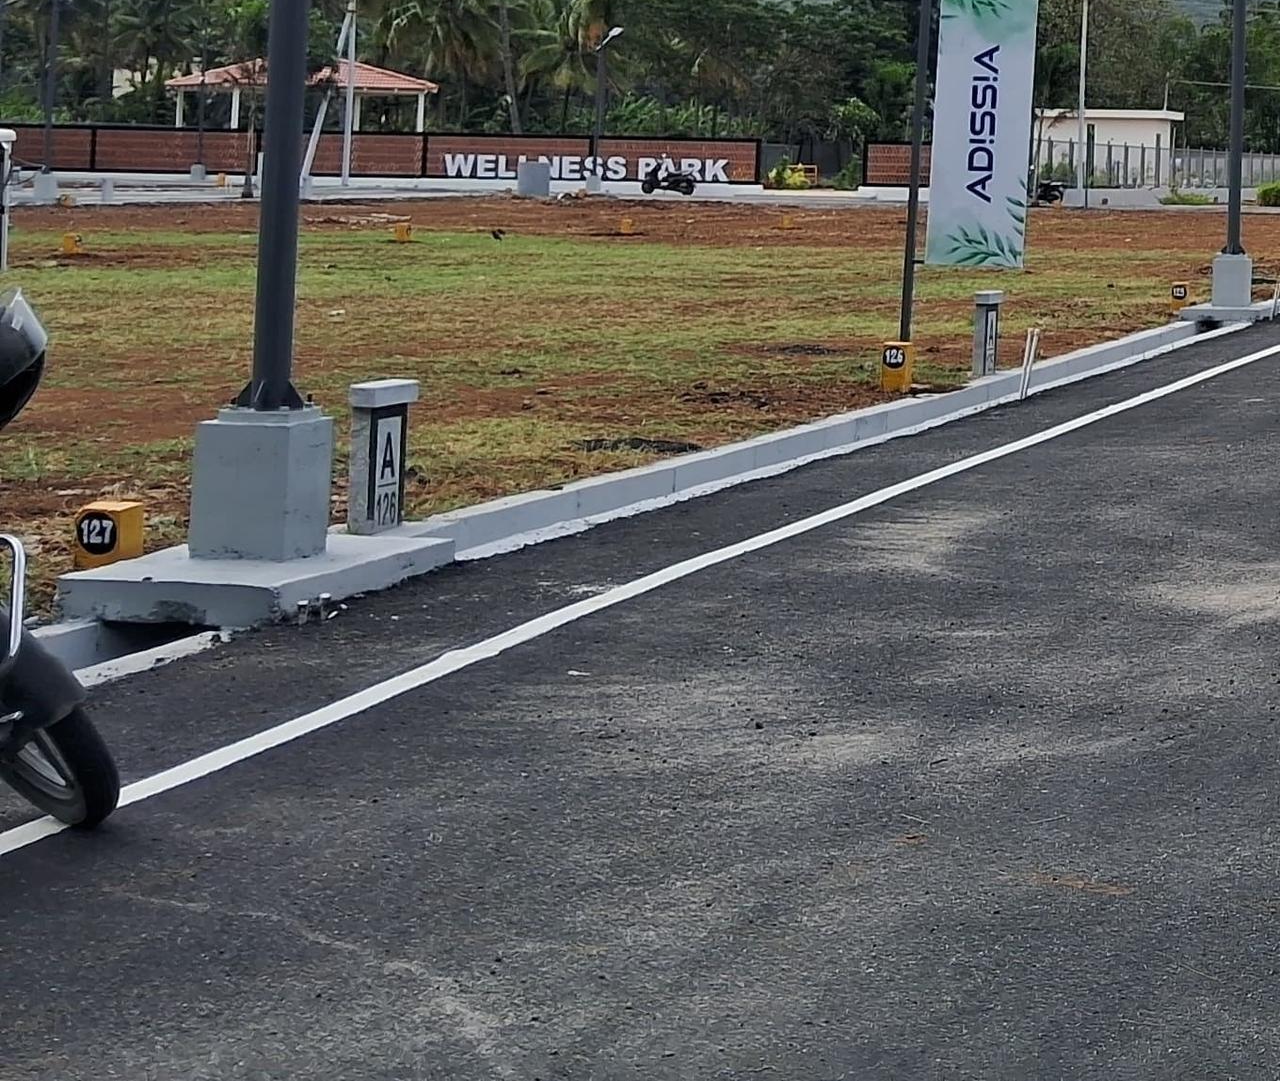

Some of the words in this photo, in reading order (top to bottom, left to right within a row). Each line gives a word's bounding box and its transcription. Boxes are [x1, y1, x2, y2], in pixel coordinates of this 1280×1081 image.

[966, 45, 1000, 203] ADISSIA
[637, 157, 730, 182] PARK
[885, 348, 904, 364] 126
[380, 431, 395, 480] A
[376, 491, 396, 526] 126
[80, 519, 113, 544] 127
